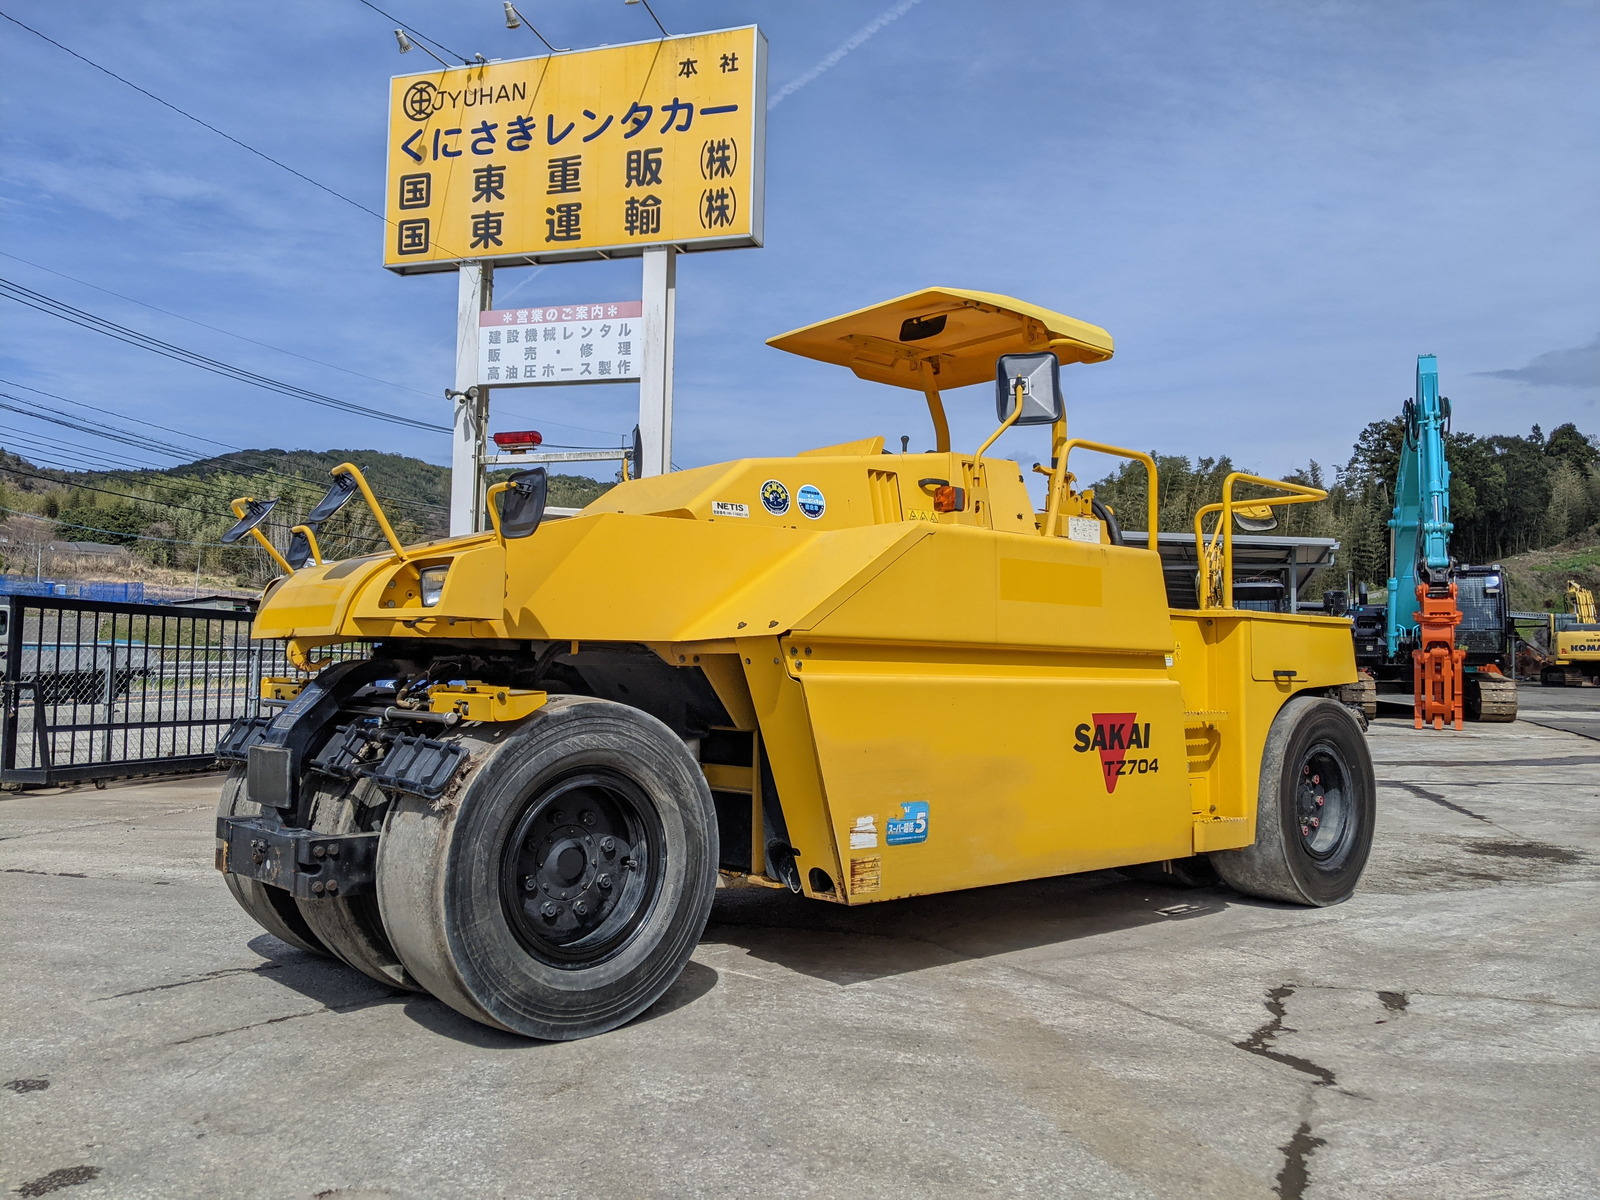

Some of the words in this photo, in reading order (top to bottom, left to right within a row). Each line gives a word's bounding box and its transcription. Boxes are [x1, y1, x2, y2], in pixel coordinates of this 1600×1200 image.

[678, 52, 739, 78] 本社
[401, 97, 739, 162] くにさきレンタカー
[488, 323, 632, 345] 建設機械レンタル
[487, 359, 632, 381] 高油圧ホース製作
[716, 502, 744, 512] NETIS
[1073, 723, 1151, 753] SAKAI
[1104, 758, 1159, 777] TZ704
[914, 812, 926, 833] 5
